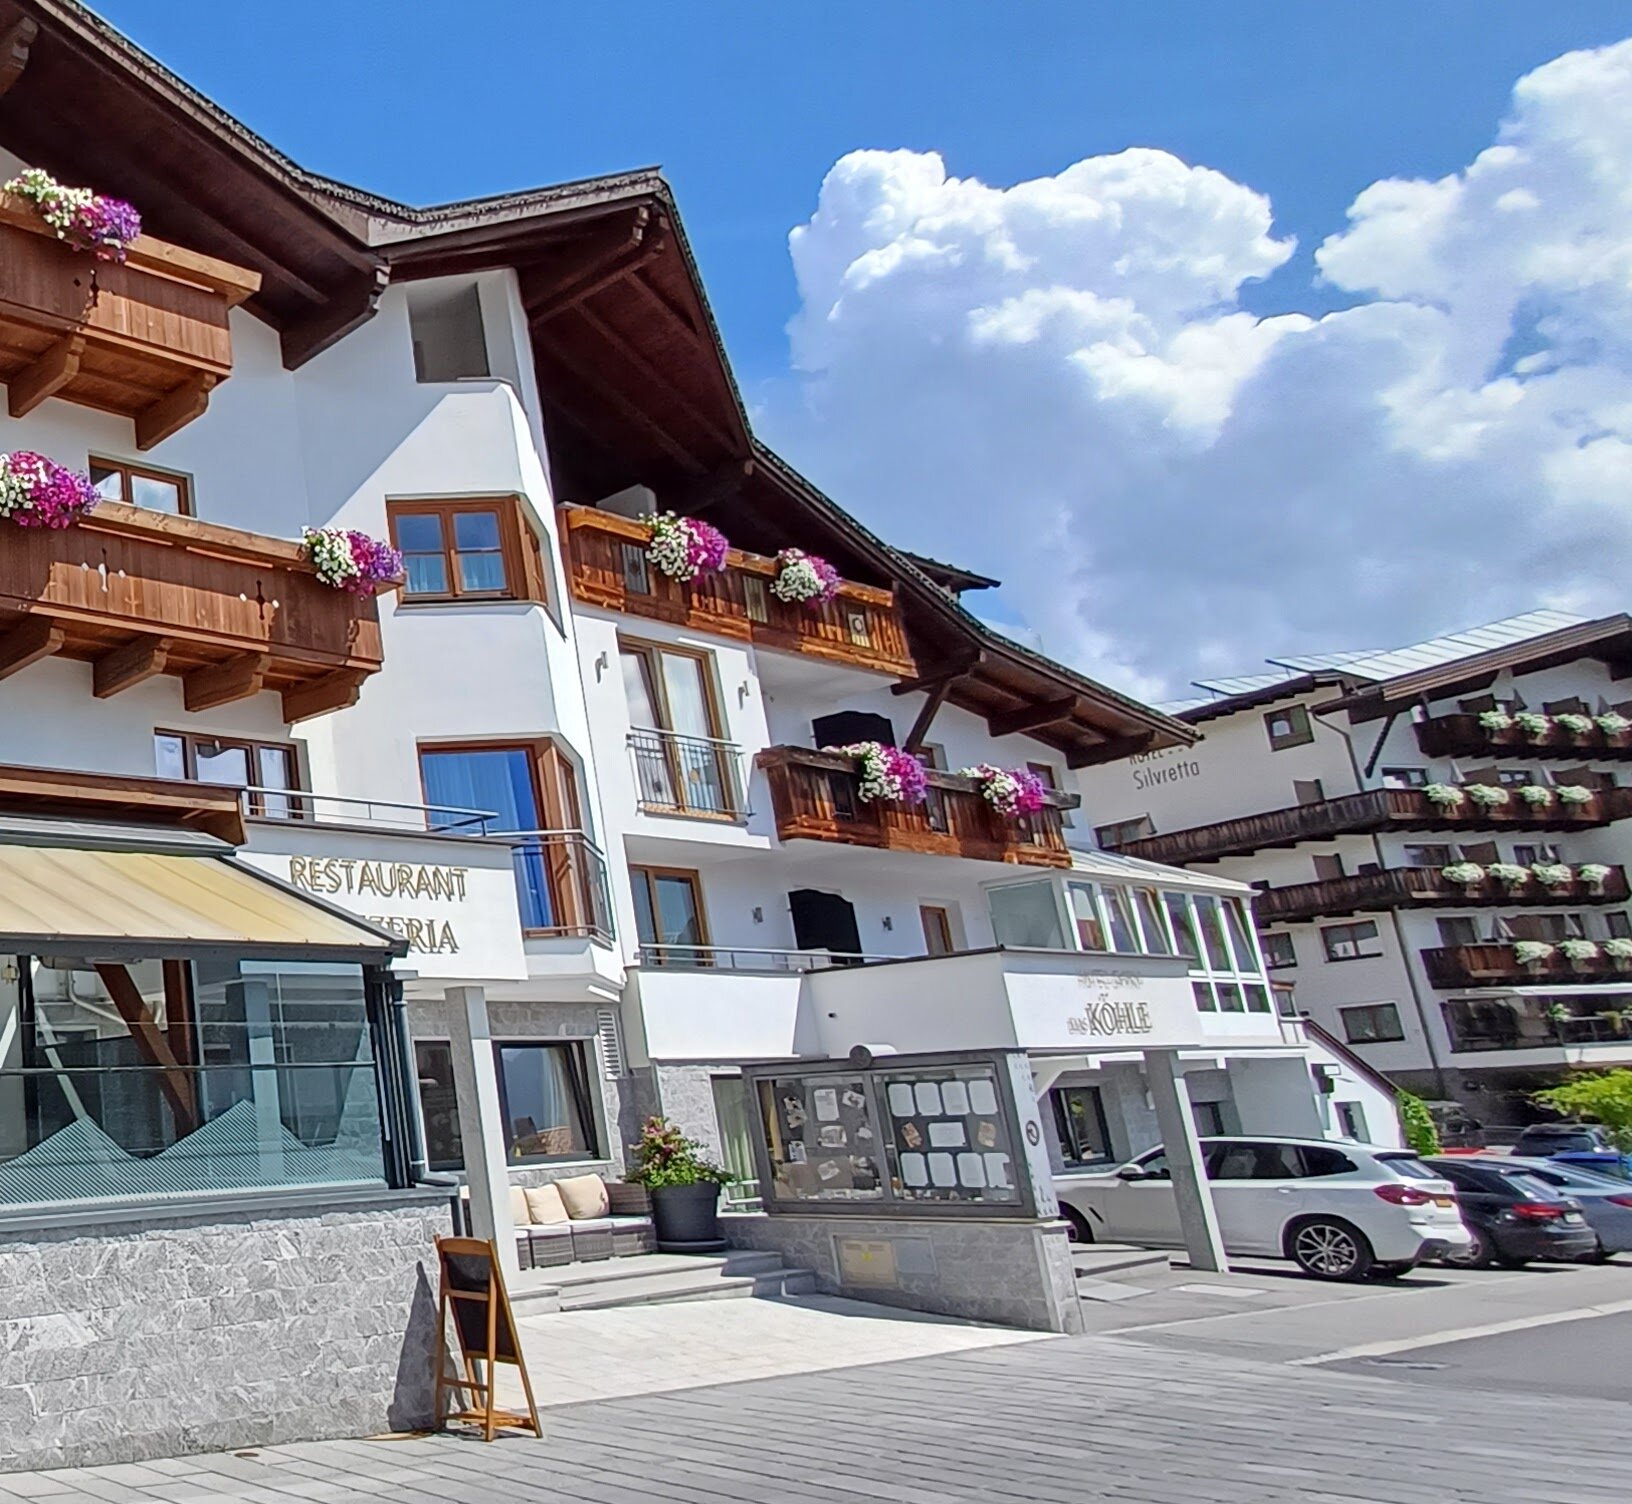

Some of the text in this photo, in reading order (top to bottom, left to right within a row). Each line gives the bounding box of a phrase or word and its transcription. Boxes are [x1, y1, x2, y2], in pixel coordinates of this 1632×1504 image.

[1132, 761, 1200, 790] Silvretta
[289, 855, 468, 902] RESTAURANT
[1085, 992, 1152, 1036] KÖHLE
